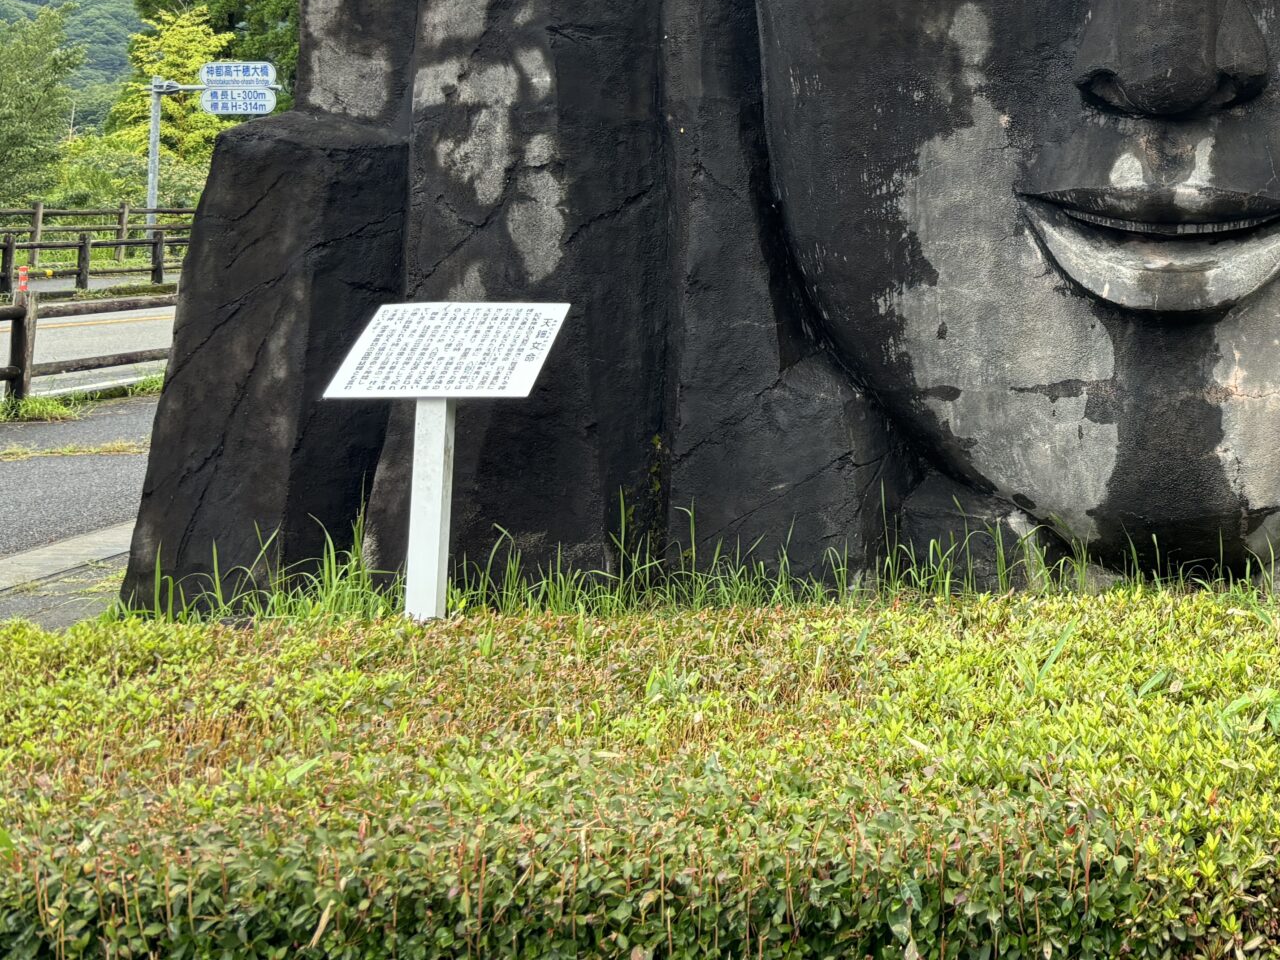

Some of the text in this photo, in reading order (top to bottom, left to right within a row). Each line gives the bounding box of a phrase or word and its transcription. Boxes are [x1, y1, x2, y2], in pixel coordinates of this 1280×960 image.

[206, 65, 269, 77] 神都高千穂大橋
